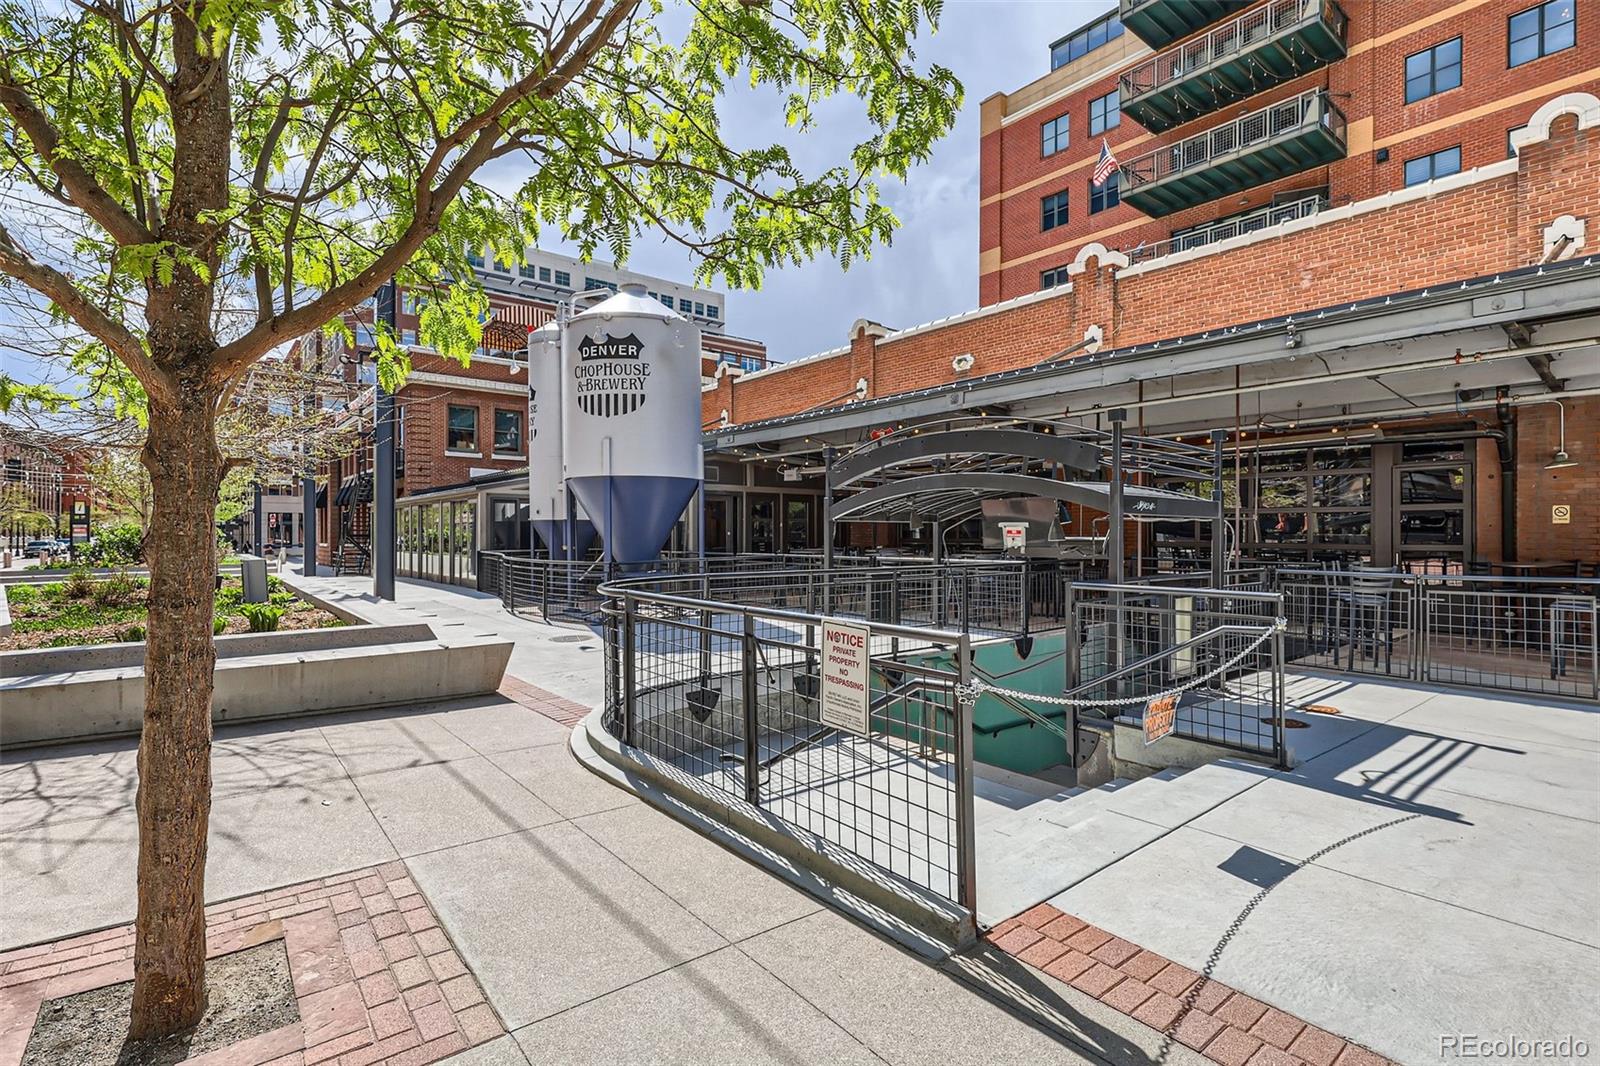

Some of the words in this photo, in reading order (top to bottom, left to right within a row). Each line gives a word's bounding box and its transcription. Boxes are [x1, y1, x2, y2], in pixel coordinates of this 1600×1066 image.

[582, 344, 637, 358] DENVER
[575, 362, 651, 379] CHOPHOUSE
[826, 630, 864, 648] NOTICE
[832, 645, 857, 657] PRIVATE
[828, 654, 861, 669] PROPERTY
[839, 668, 849, 676] NO
[824, 674, 865, 691] TRESPASSING
